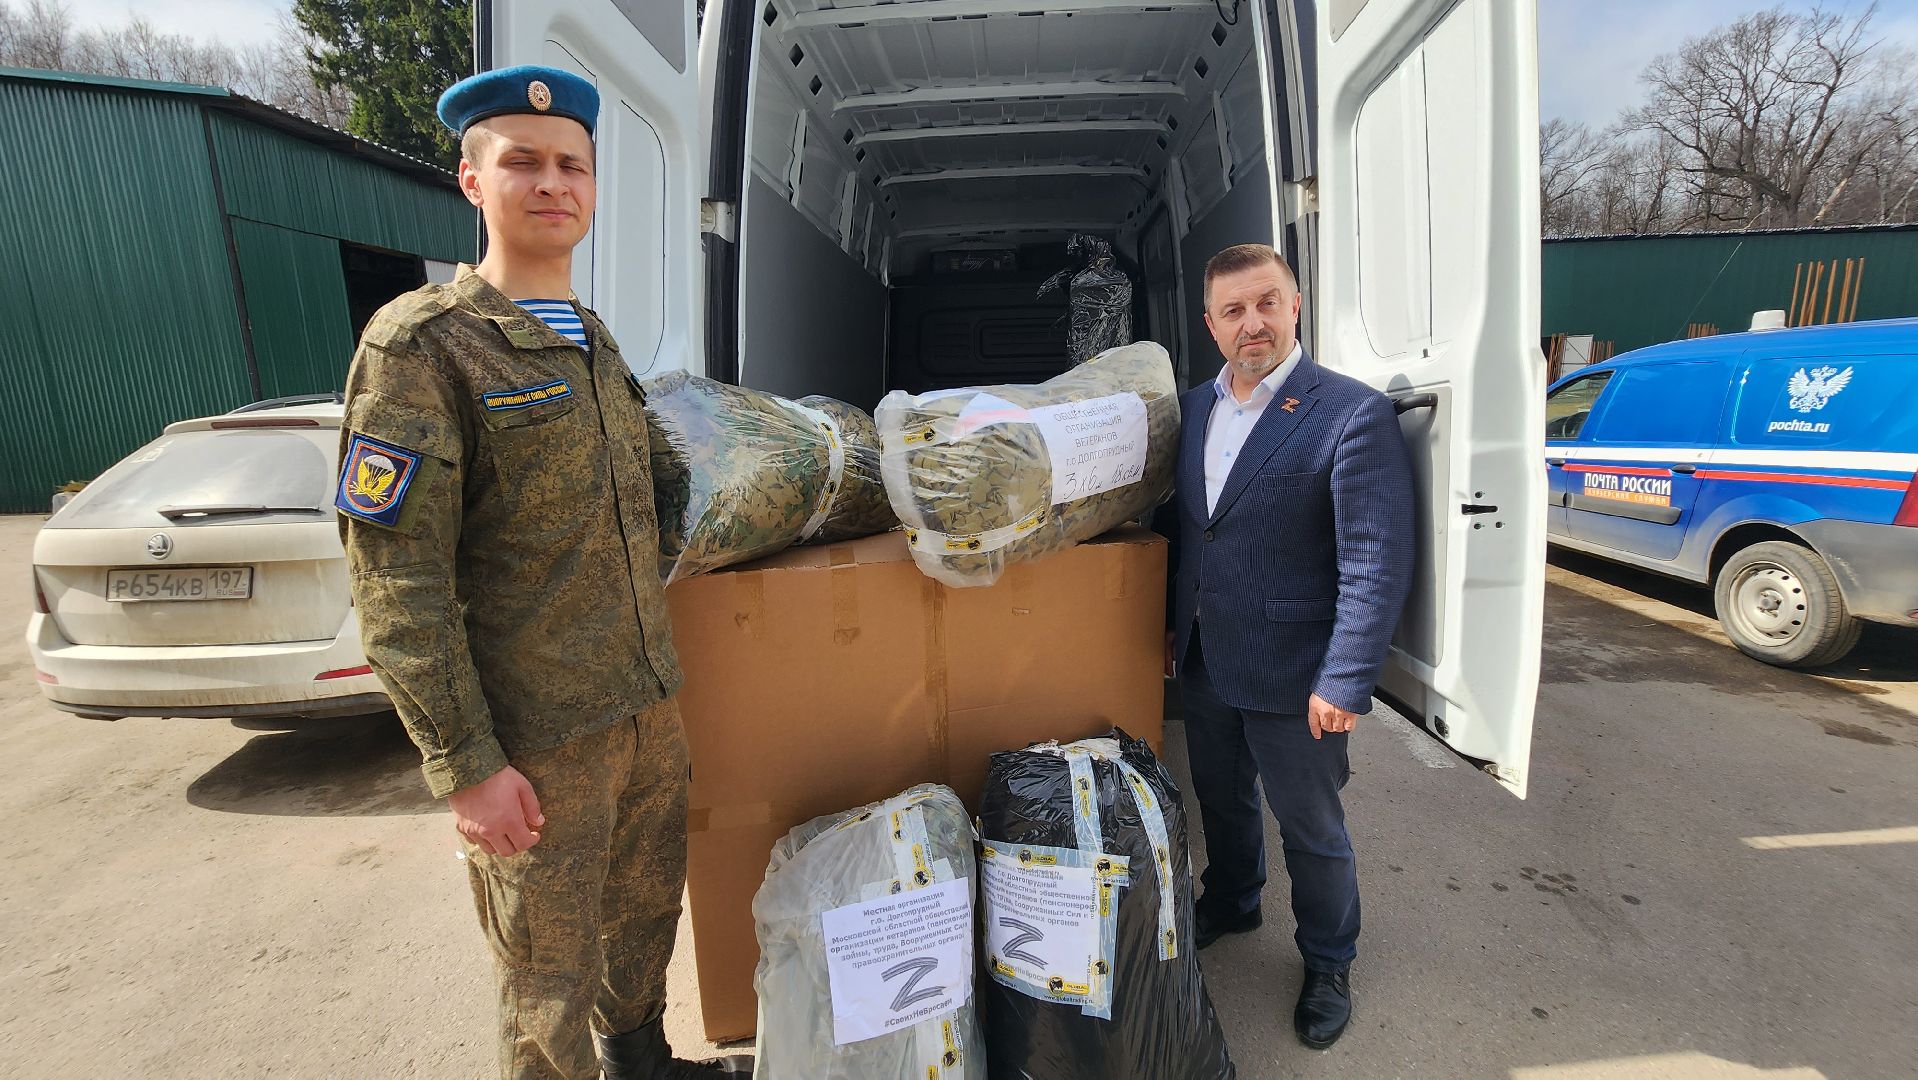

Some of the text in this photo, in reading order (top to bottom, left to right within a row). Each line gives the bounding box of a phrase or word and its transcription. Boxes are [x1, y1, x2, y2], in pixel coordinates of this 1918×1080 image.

[530, 390, 548, 400] СИЛЫ
[546, 384, 568, 396] РОССИИ
[1768, 419, 1831, 433] pochta.ru
[1075, 432, 1118, 448] ВЕТЕРАНОВ
[1584, 472, 1671, 496] ПОЧТА РОССИИ
[209, 570, 243, 588] 197
[863, 904, 895, 917] Местная
[832, 927, 881, 944] Московской
